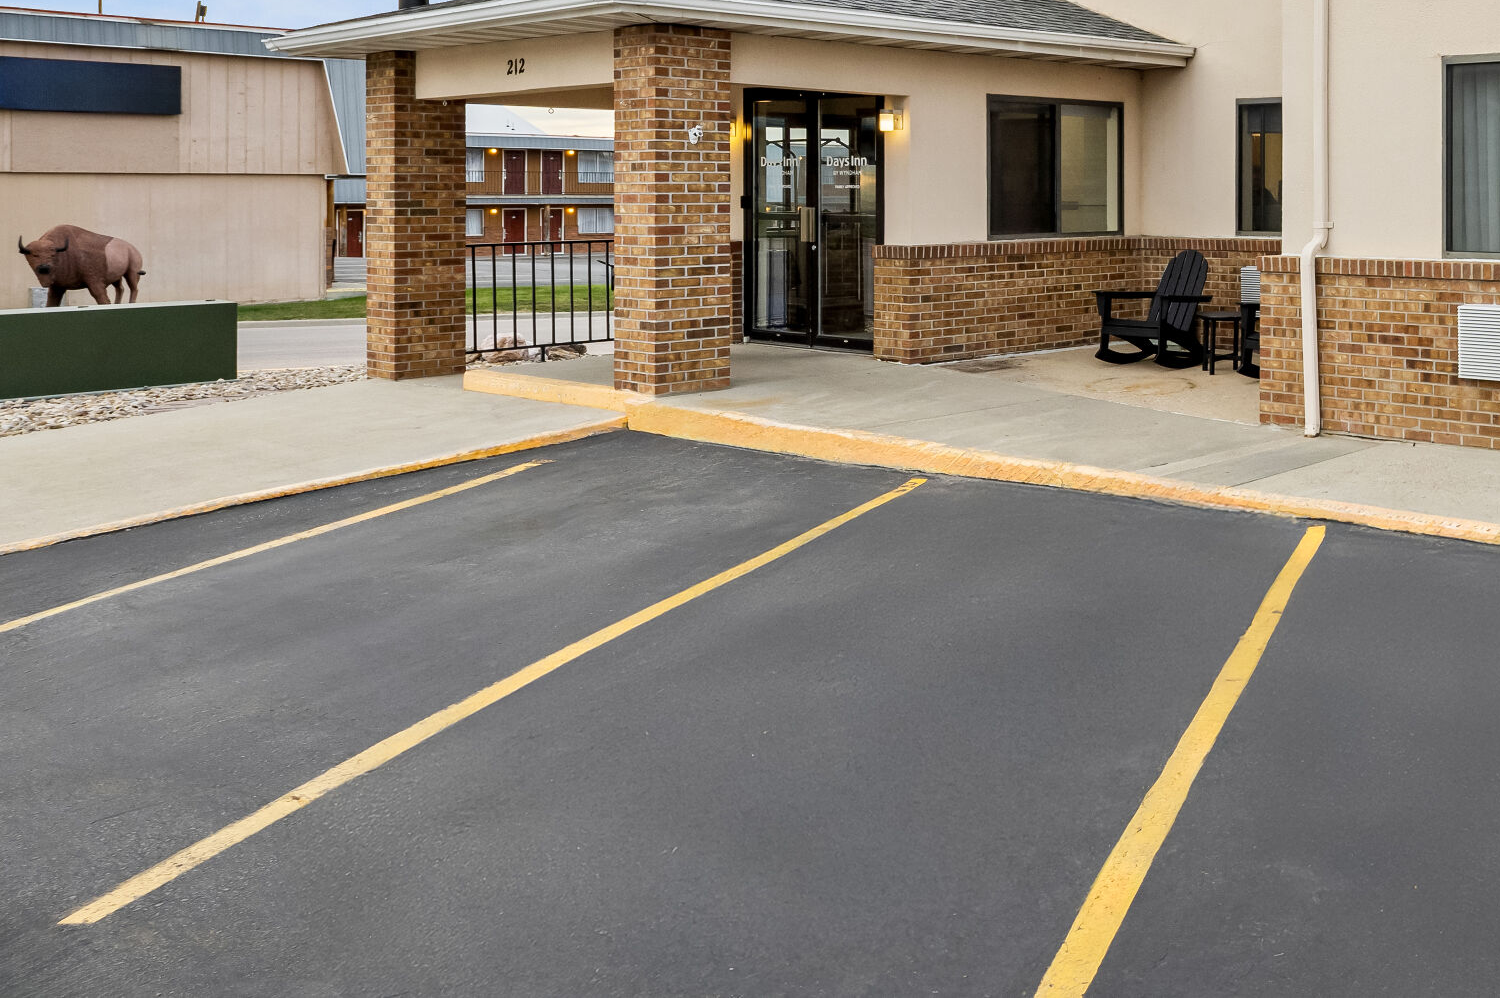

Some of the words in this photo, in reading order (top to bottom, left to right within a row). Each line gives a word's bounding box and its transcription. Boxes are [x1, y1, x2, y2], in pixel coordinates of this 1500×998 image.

[507, 58, 525, 75] 212
[826, 155, 850, 168] Days
[850, 155, 868, 166] Inn
